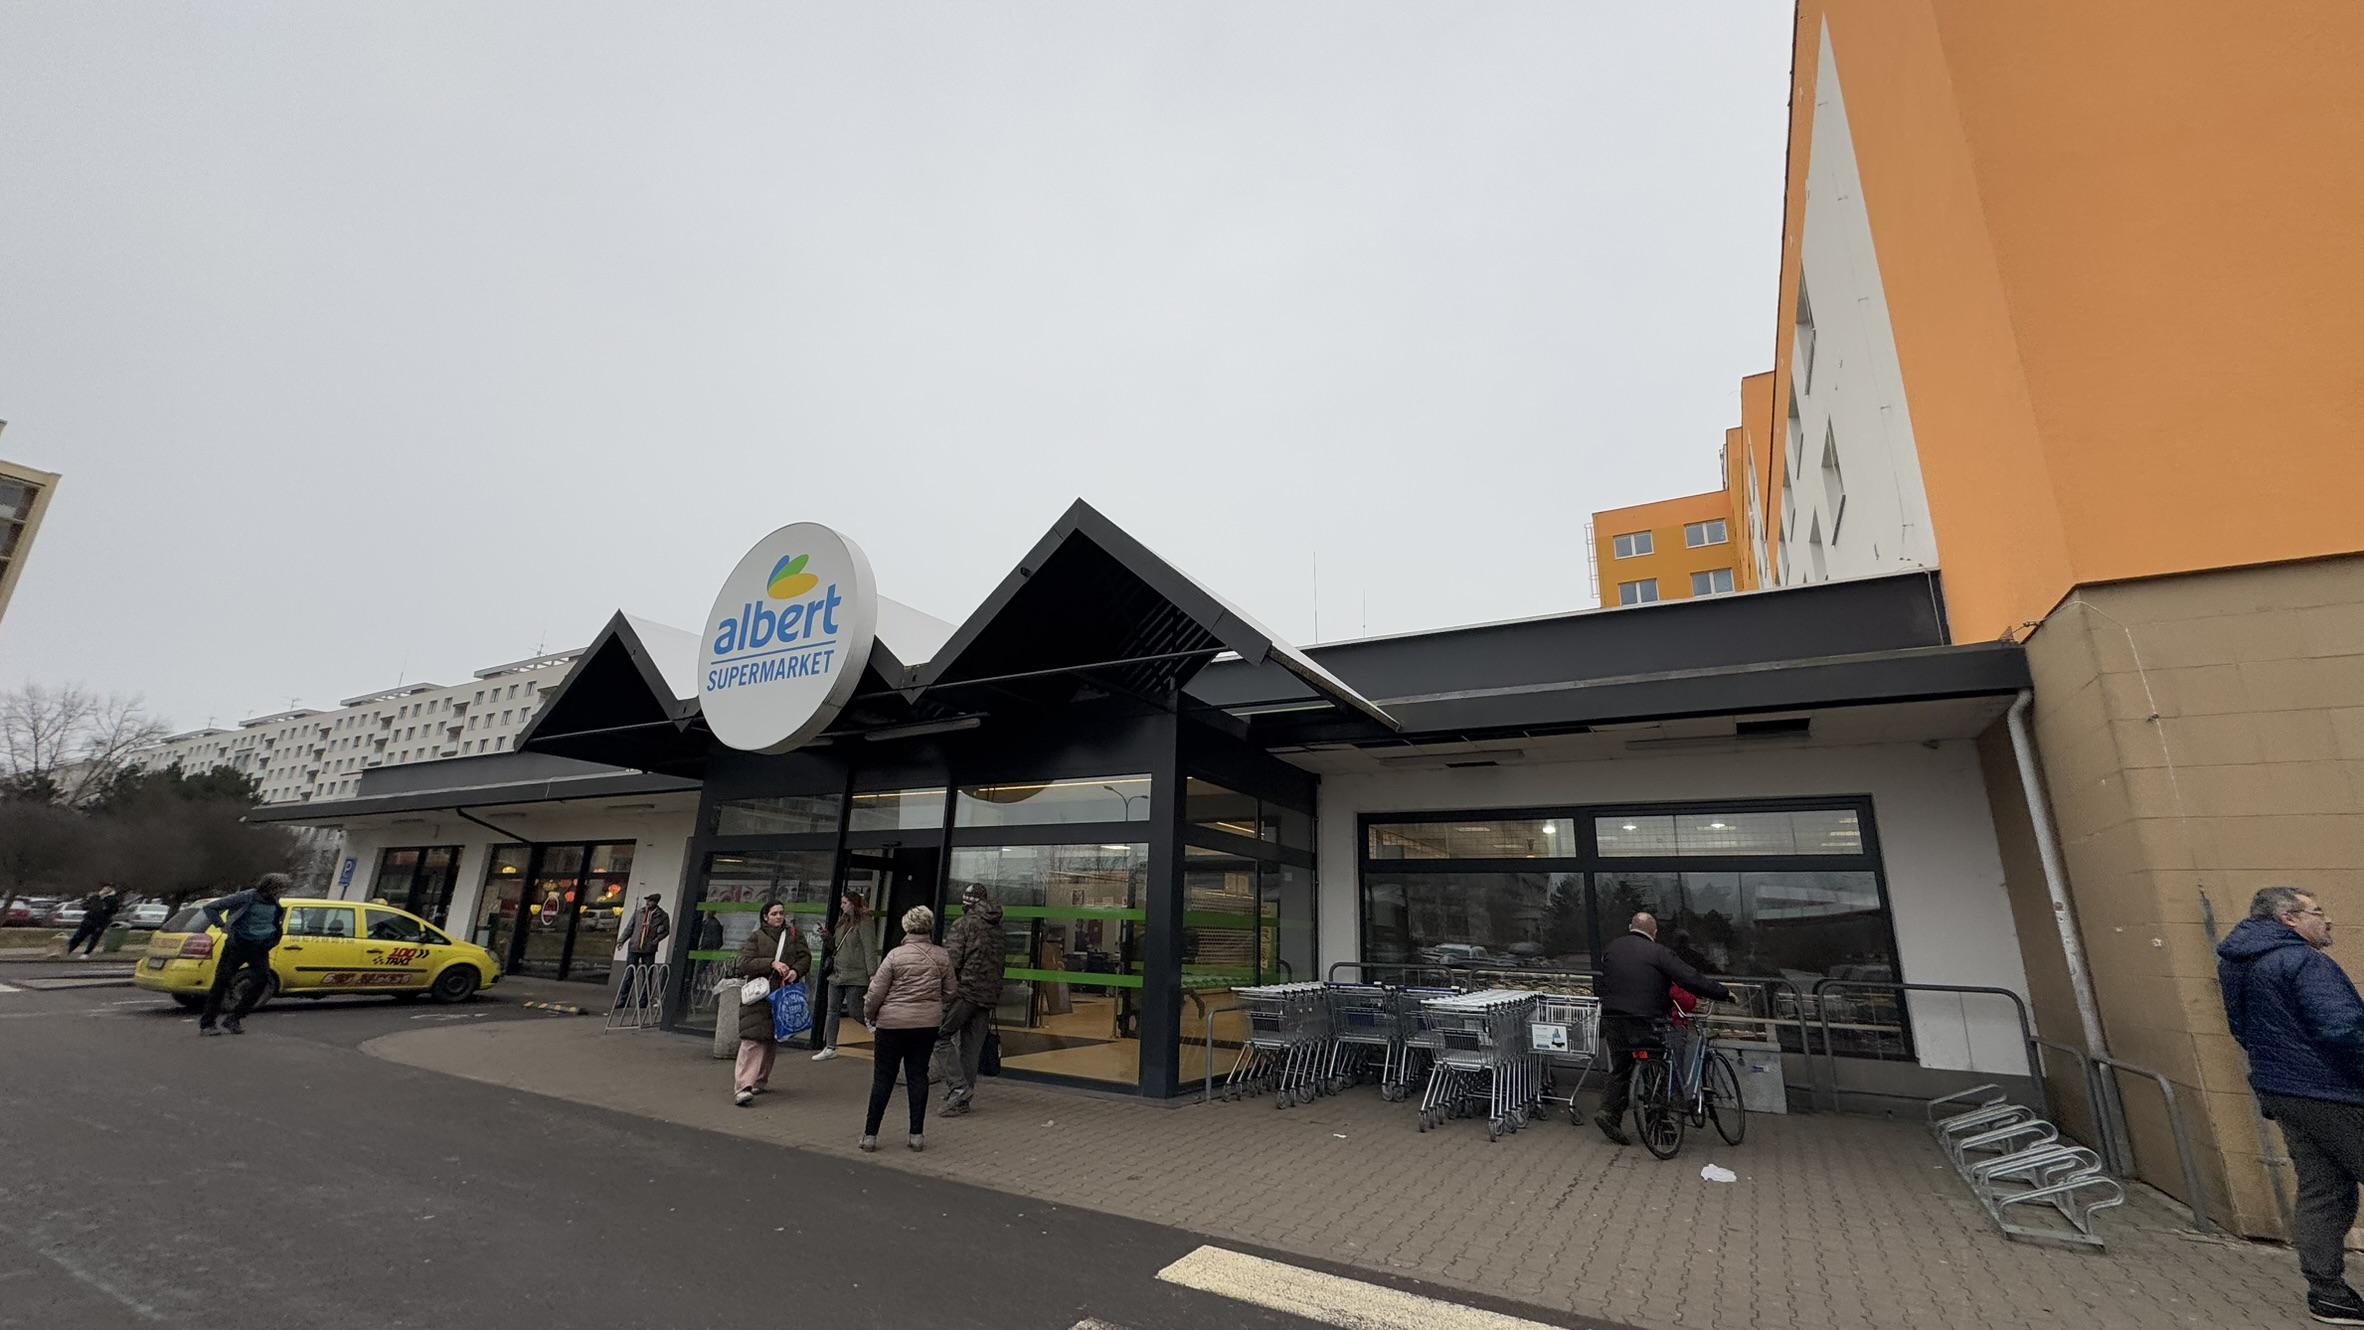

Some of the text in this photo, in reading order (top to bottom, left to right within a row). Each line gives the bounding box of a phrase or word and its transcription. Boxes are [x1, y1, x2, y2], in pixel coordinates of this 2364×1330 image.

[713, 584, 842, 655] albert
[707, 649, 835, 692] SUPERMARKET
[385, 957, 412, 966] TAXI
[389, 947, 417, 958] 100
